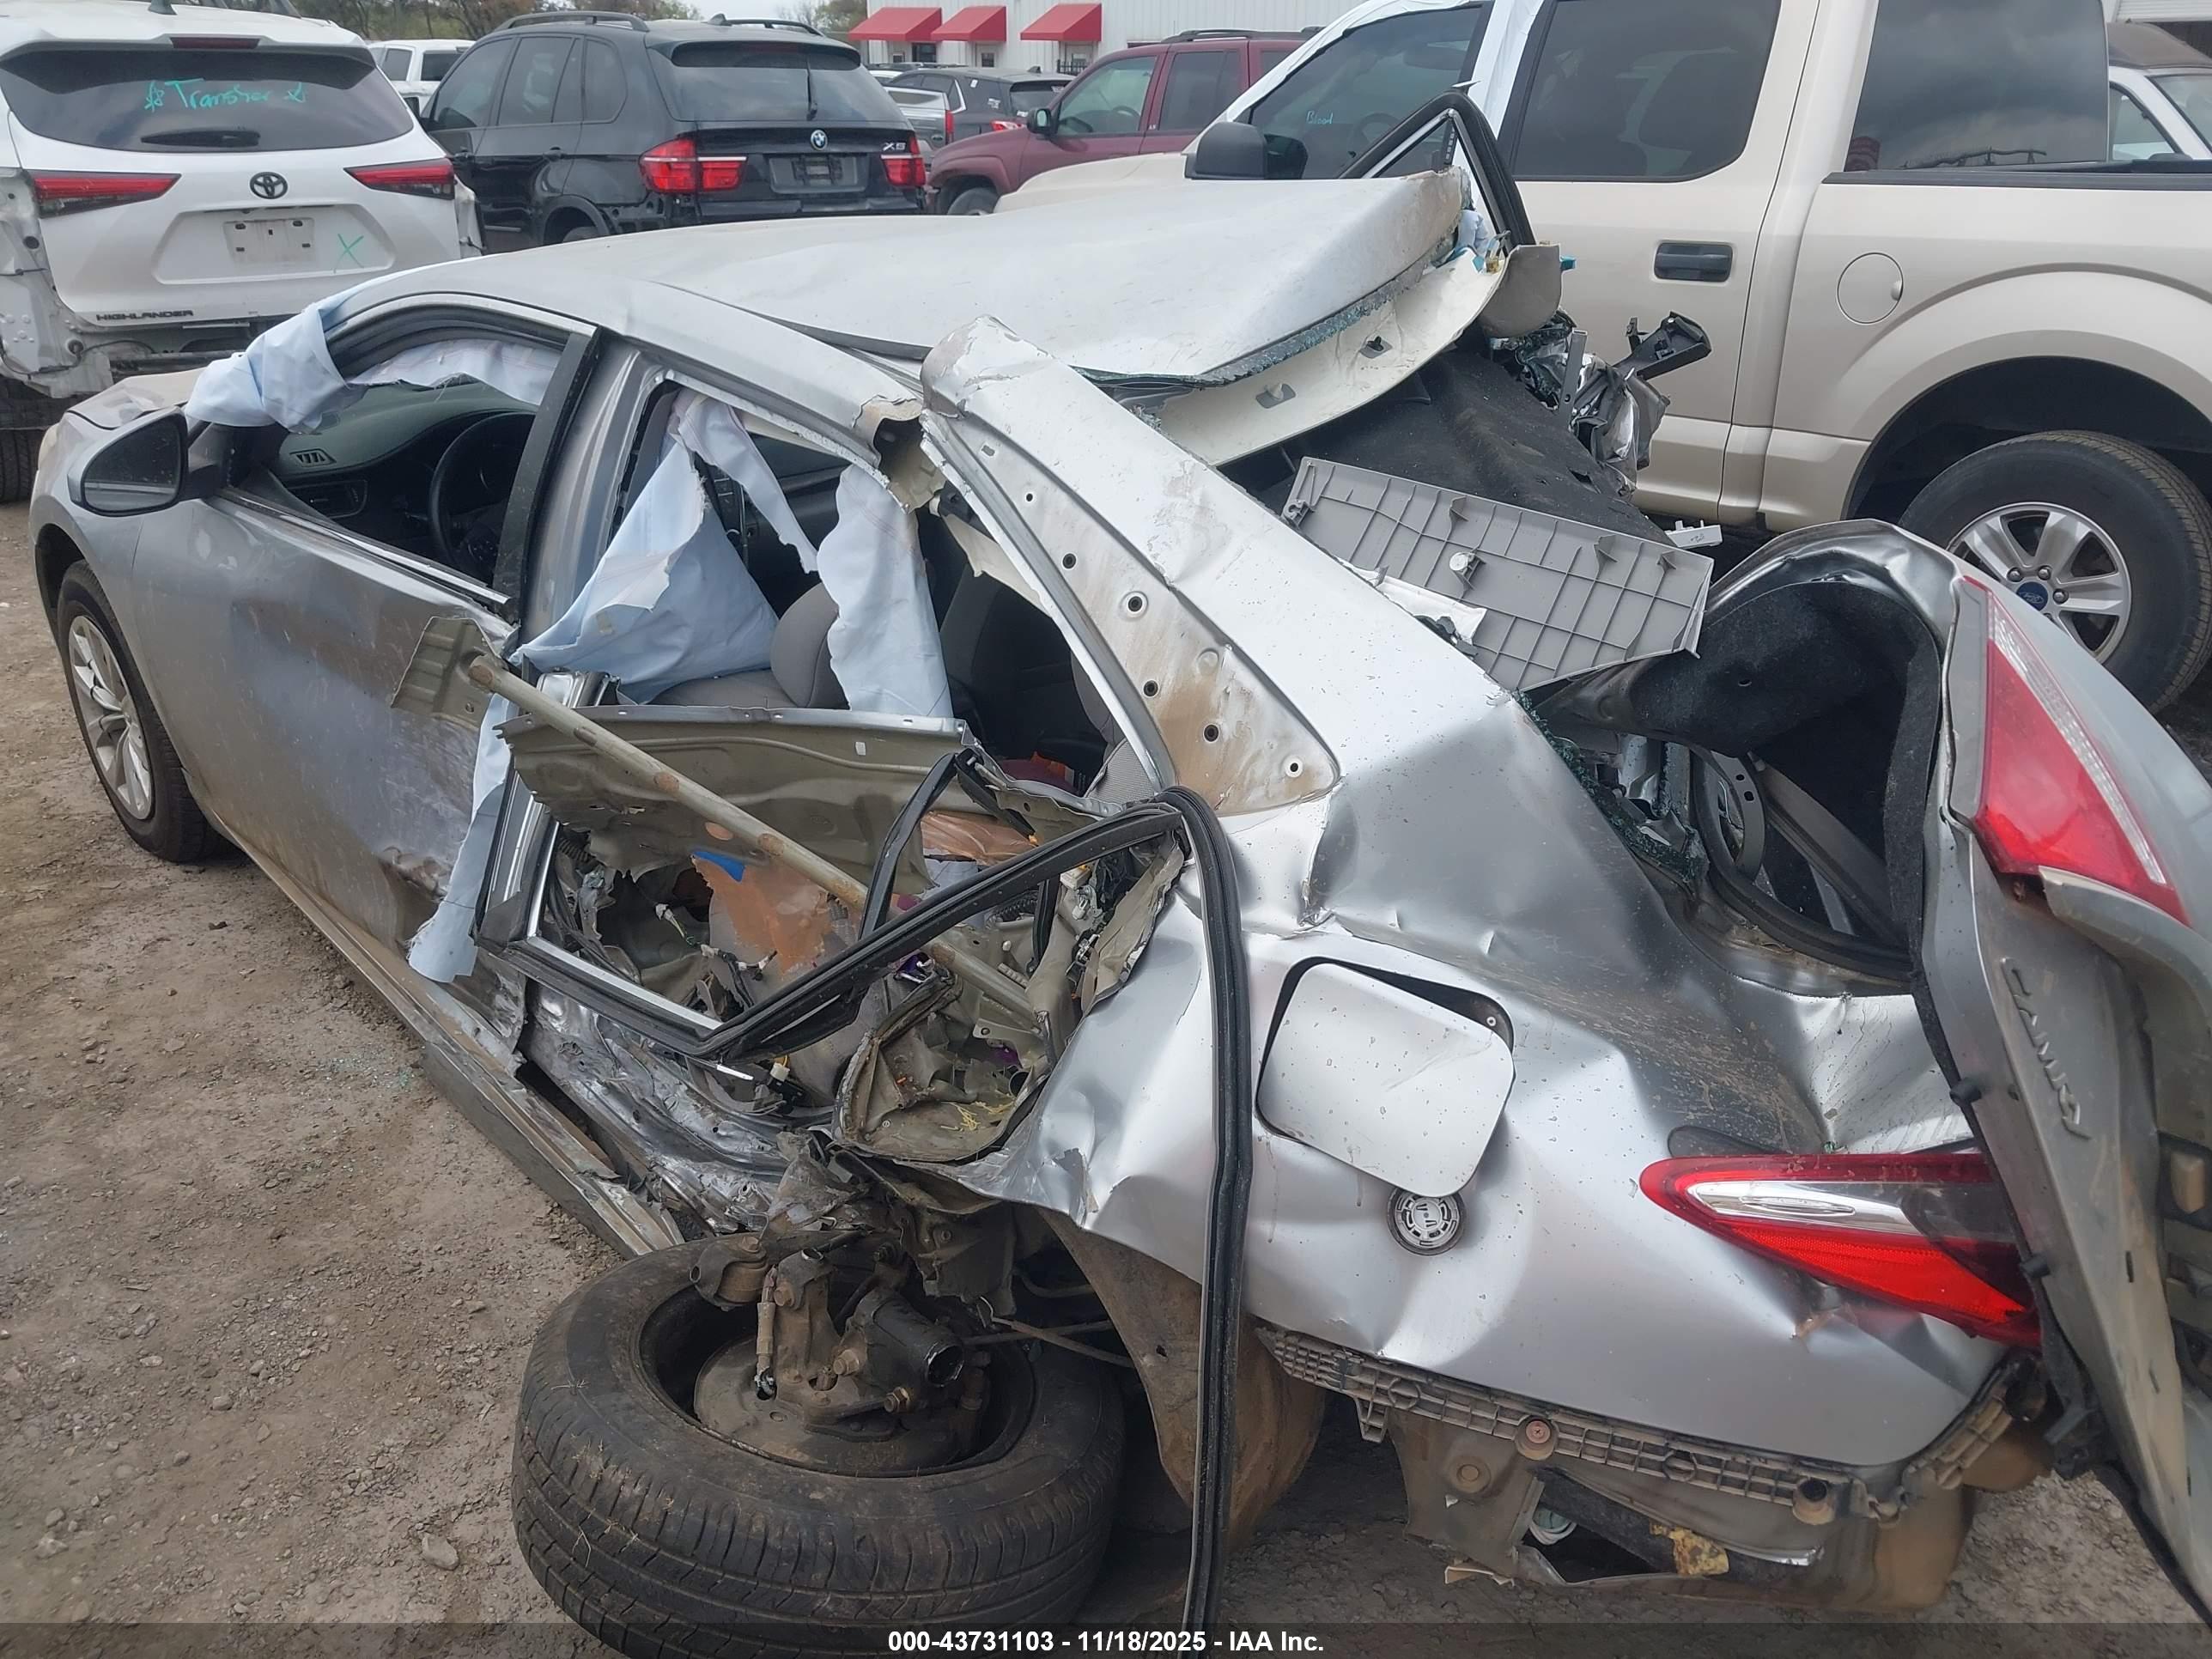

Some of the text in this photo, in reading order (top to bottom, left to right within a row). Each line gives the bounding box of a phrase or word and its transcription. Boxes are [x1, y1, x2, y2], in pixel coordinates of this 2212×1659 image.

[1305, 110, 1334, 125] Blood
[883, 142, 907, 151] X5
[95, 309, 194, 321] HIGHLANDER
[1999, 956, 2093, 1141] CAMRY
